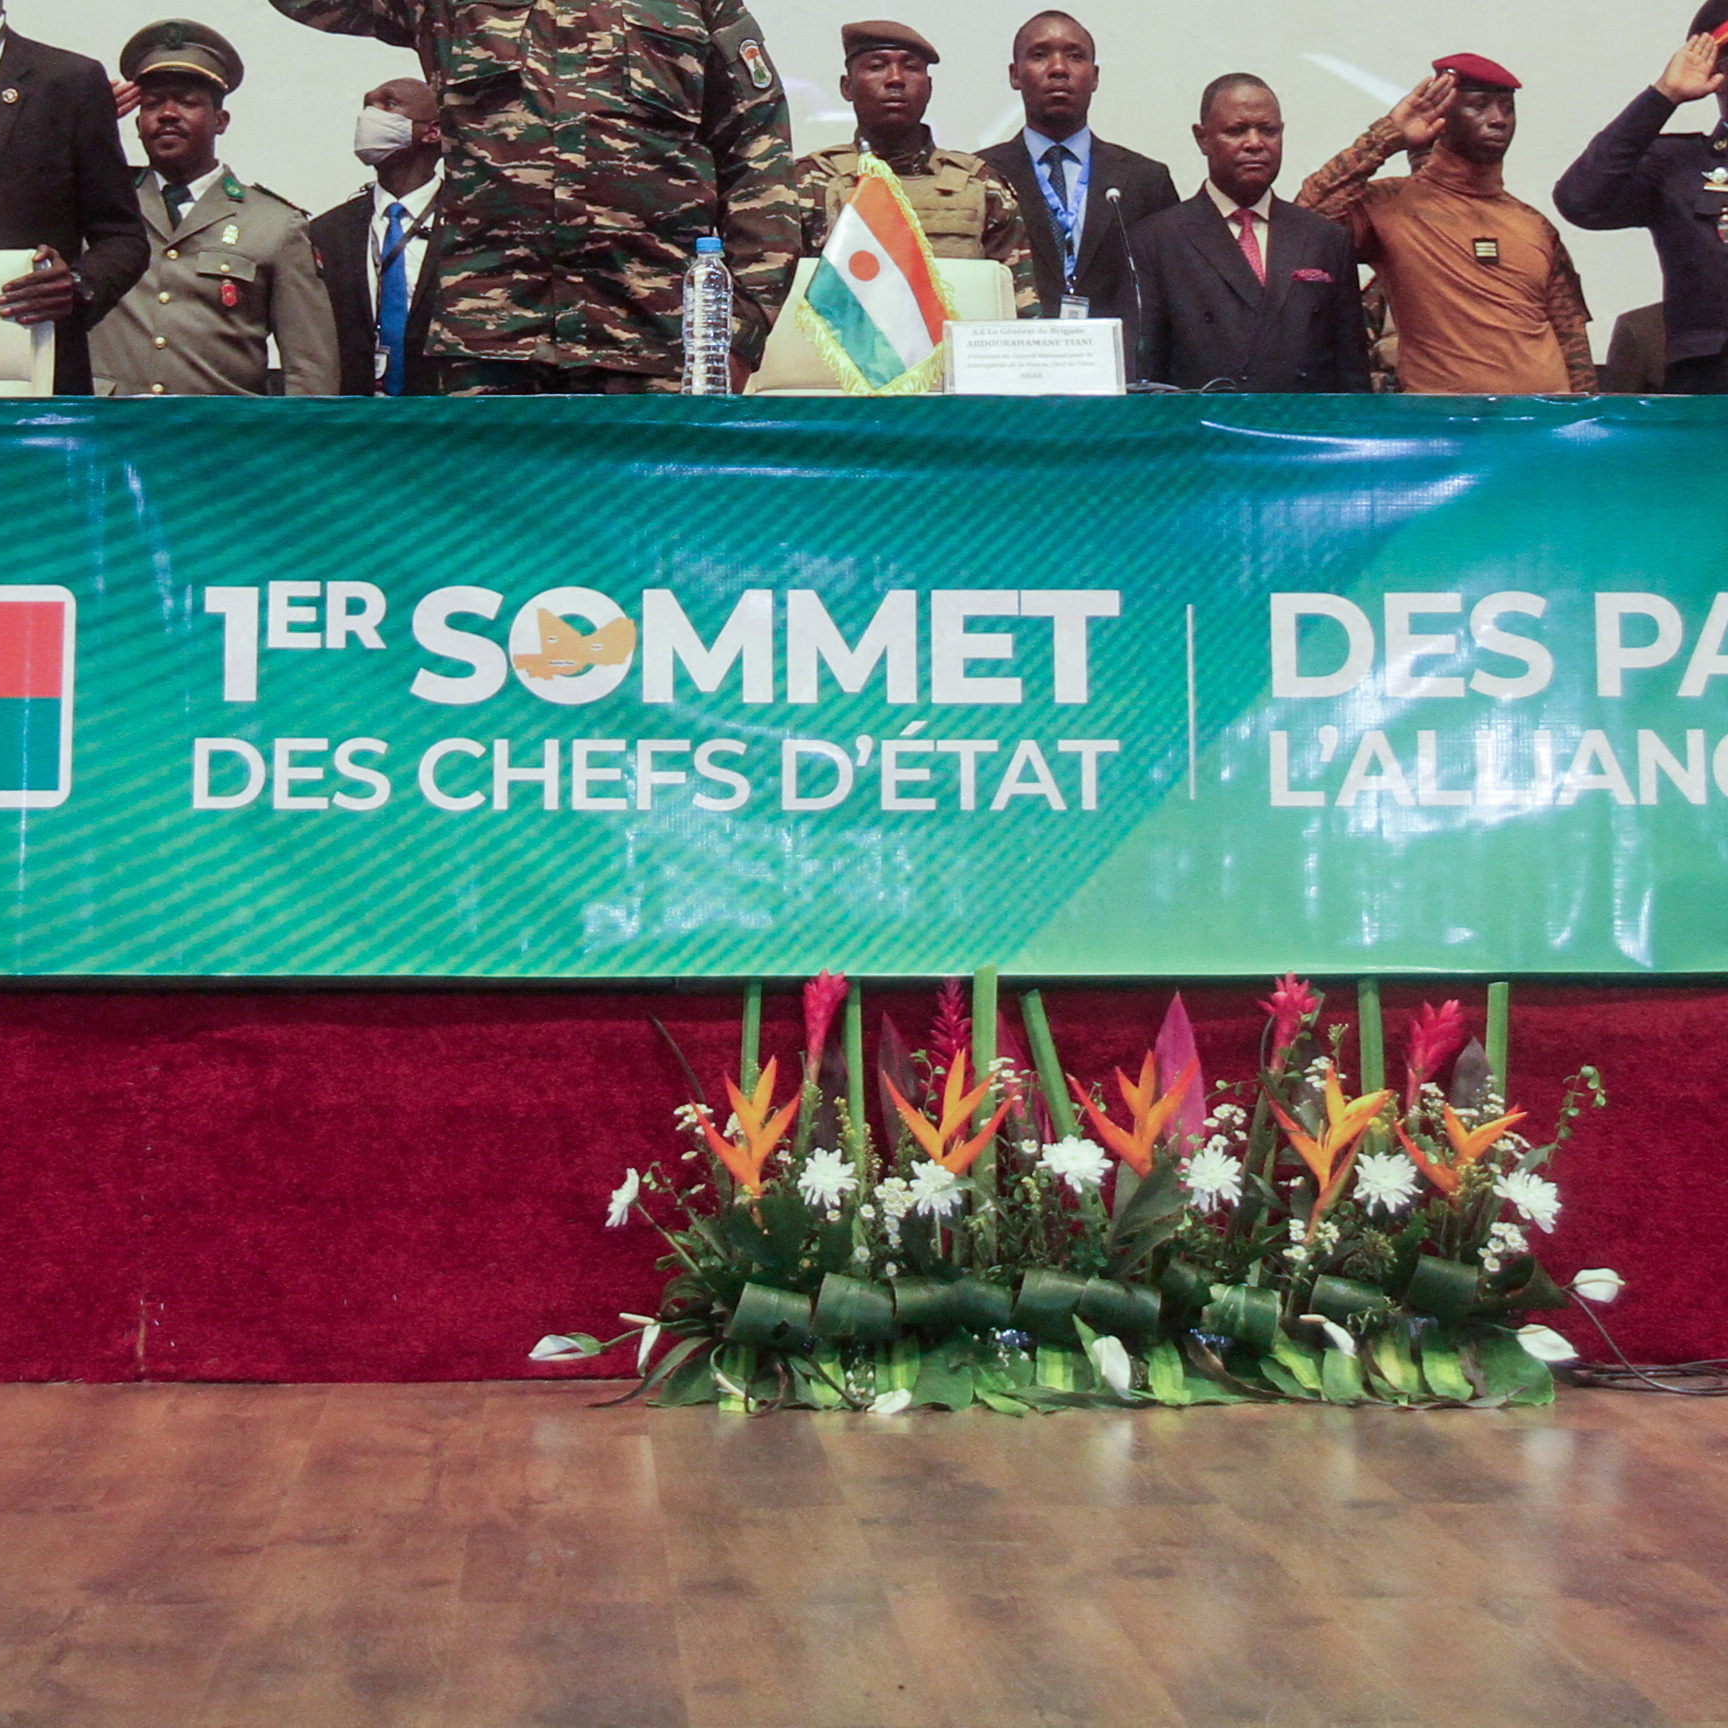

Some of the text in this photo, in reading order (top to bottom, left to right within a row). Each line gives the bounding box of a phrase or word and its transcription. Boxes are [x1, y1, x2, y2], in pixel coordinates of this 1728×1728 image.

[966, 337, 1093, 347] ABDOURAHAMANE TIANI
[1050, 327, 1084, 336] Brigade
[204, 581, 1121, 706] 1ER SOMMET
[1270, 590, 1555, 699] DES
[191, 737, 391, 812] DES
[418, 737, 752, 812] CHEFS
